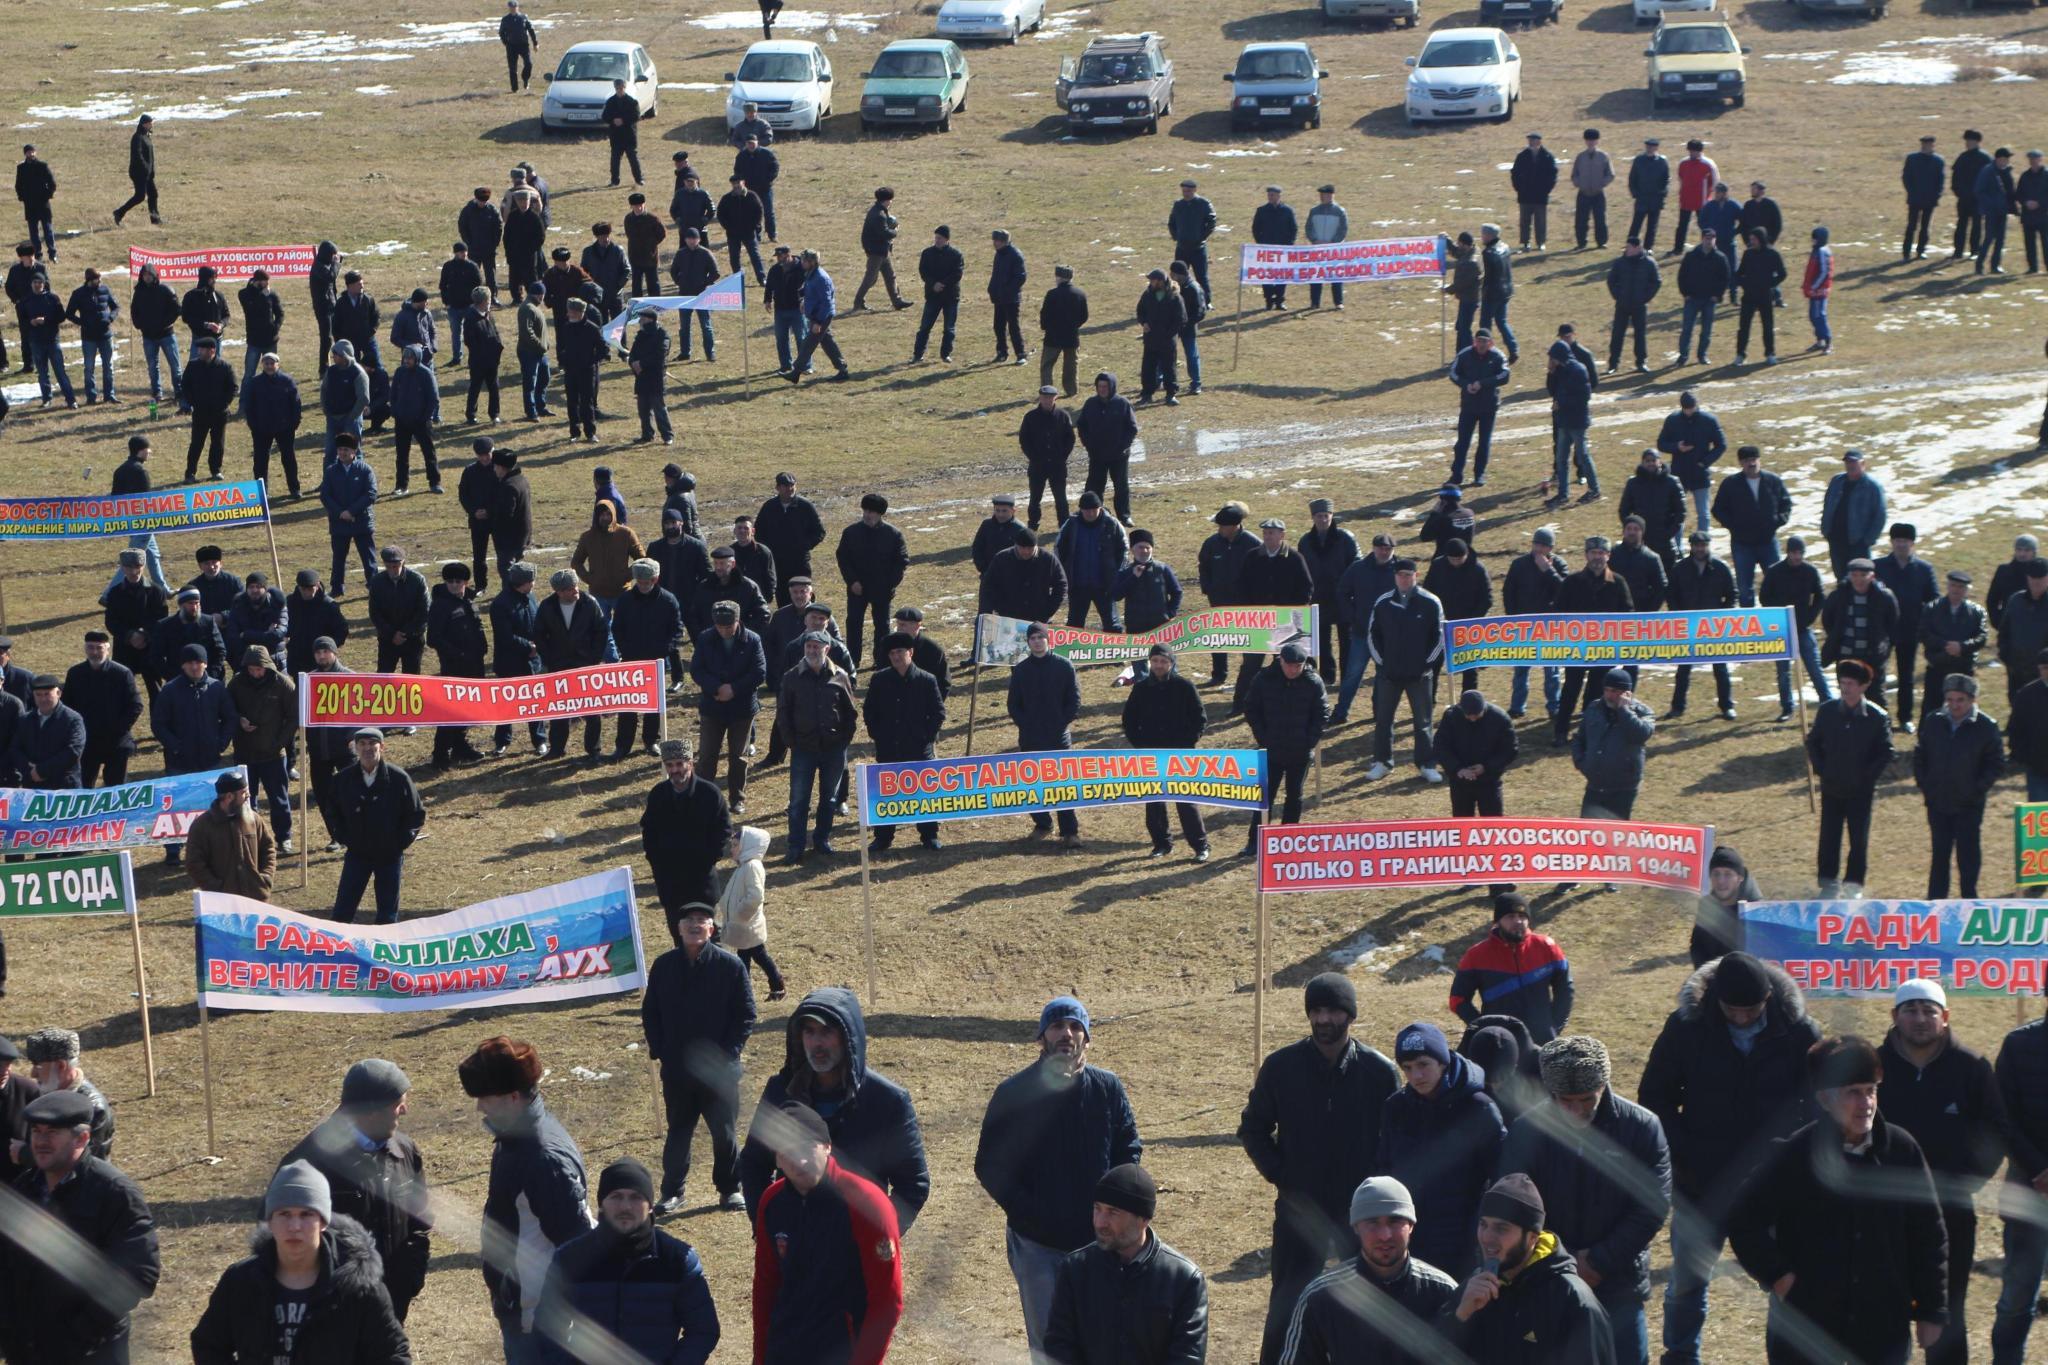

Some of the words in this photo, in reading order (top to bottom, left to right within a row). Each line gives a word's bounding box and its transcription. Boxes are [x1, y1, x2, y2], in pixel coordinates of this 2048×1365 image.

[210, 252, 274, 263] АУХОВСКОГО
[277, 249, 314, 260] РАЙОНА
[226, 265, 238, 275] 23
[1247, 267, 1294, 280] РОЗНИ
[1298, 262, 1372, 280] БРАТСКИХ
[1377, 259, 1440, 274] НАРОДОВ
[1256, 249, 1283, 263] НЕТ
[192, 487, 245, 509] АУХА
[68, 521, 100, 534] МИРА
[104, 521, 128, 533] ДЛЯ
[131, 515, 190, 530] БУДУЩИХ
[193, 504, 263, 524] ПОКОЛЕНИЙ
[1188, 610, 1278, 633] СТАРИКИ!
[1453, 617, 1689, 647] ВОССТАНОВЛЕНИЕ
[1695, 615, 1762, 637] АУХА
[1068, 650, 1091, 660] МЫ
[1095, 648, 1149, 659] ВЕРНЕМ
[1193, 634, 1250, 648] РОДИНУ!
[1452, 646, 1537, 666] СОХРАНЕНИЕ
[1540, 646, 1581, 659] МИРА
[1584, 646, 1616, 661] ДЛЯ
[1619, 644, 1692, 661] БУДУЩИХ
[1694, 638, 1786, 656] ПОКОЛЕНИЙ
[315, 682, 424, 716] 2013-2016
[443, 684, 481, 702] ТРИ
[490, 682, 546, 704] ГОДА
[554, 678, 570, 694] И
[518, 705, 544, 716] Р.Г.
[548, 692, 648, 713] АБДУЛАТИПОВ
[879, 755, 1158, 796] ВОССТАНОВЛЕНИЕ
[1166, 755, 1241, 778] АУХА
[21, 784, 155, 822] АЛЛАХА
[876, 795, 988, 818] СОХРАНЕНИЕ
[991, 790, 1039, 808] МИРА
[1044, 786, 1077, 806] ДЛЯ
[1083, 782, 1162, 801] БУДУЩИХ
[1167, 780, 1263, 803] ПОКОЛЕНИЙ
[12, 819, 127, 849] РОДИНУ
[152, 809, 206, 839] АУ
[1267, 829, 1460, 854] ВОССТАНОВЛЕНИЕ
[1466, 828, 1607, 846] АУХОВСКОГО
[1613, 828, 1697, 855] РАЙОНА
[1273, 858, 1354, 881] ТОЛЬКО
[1360, 858, 1374, 877] В
[1380, 855, 1494, 877] ГРАНИЦАХ
[1499, 854, 1525, 872] 23
[1531, 854, 1632, 873] ФЕВРАЛЯ
[1637, 856, 1691, 880] 1944г
[11, 872, 43, 906] 72
[48, 866, 118, 909] ГОДА
[372, 922, 535, 967] АЛЛАХА
[1817, 914, 1940, 950] РАДИ
[208, 959, 359, 991] ВЕРНИТЕ
[367, 964, 508, 997] РОДИНУ
[535, 943, 612, 981] АУХ
[1767, 959, 1941, 990] ЕРНИТЕ
